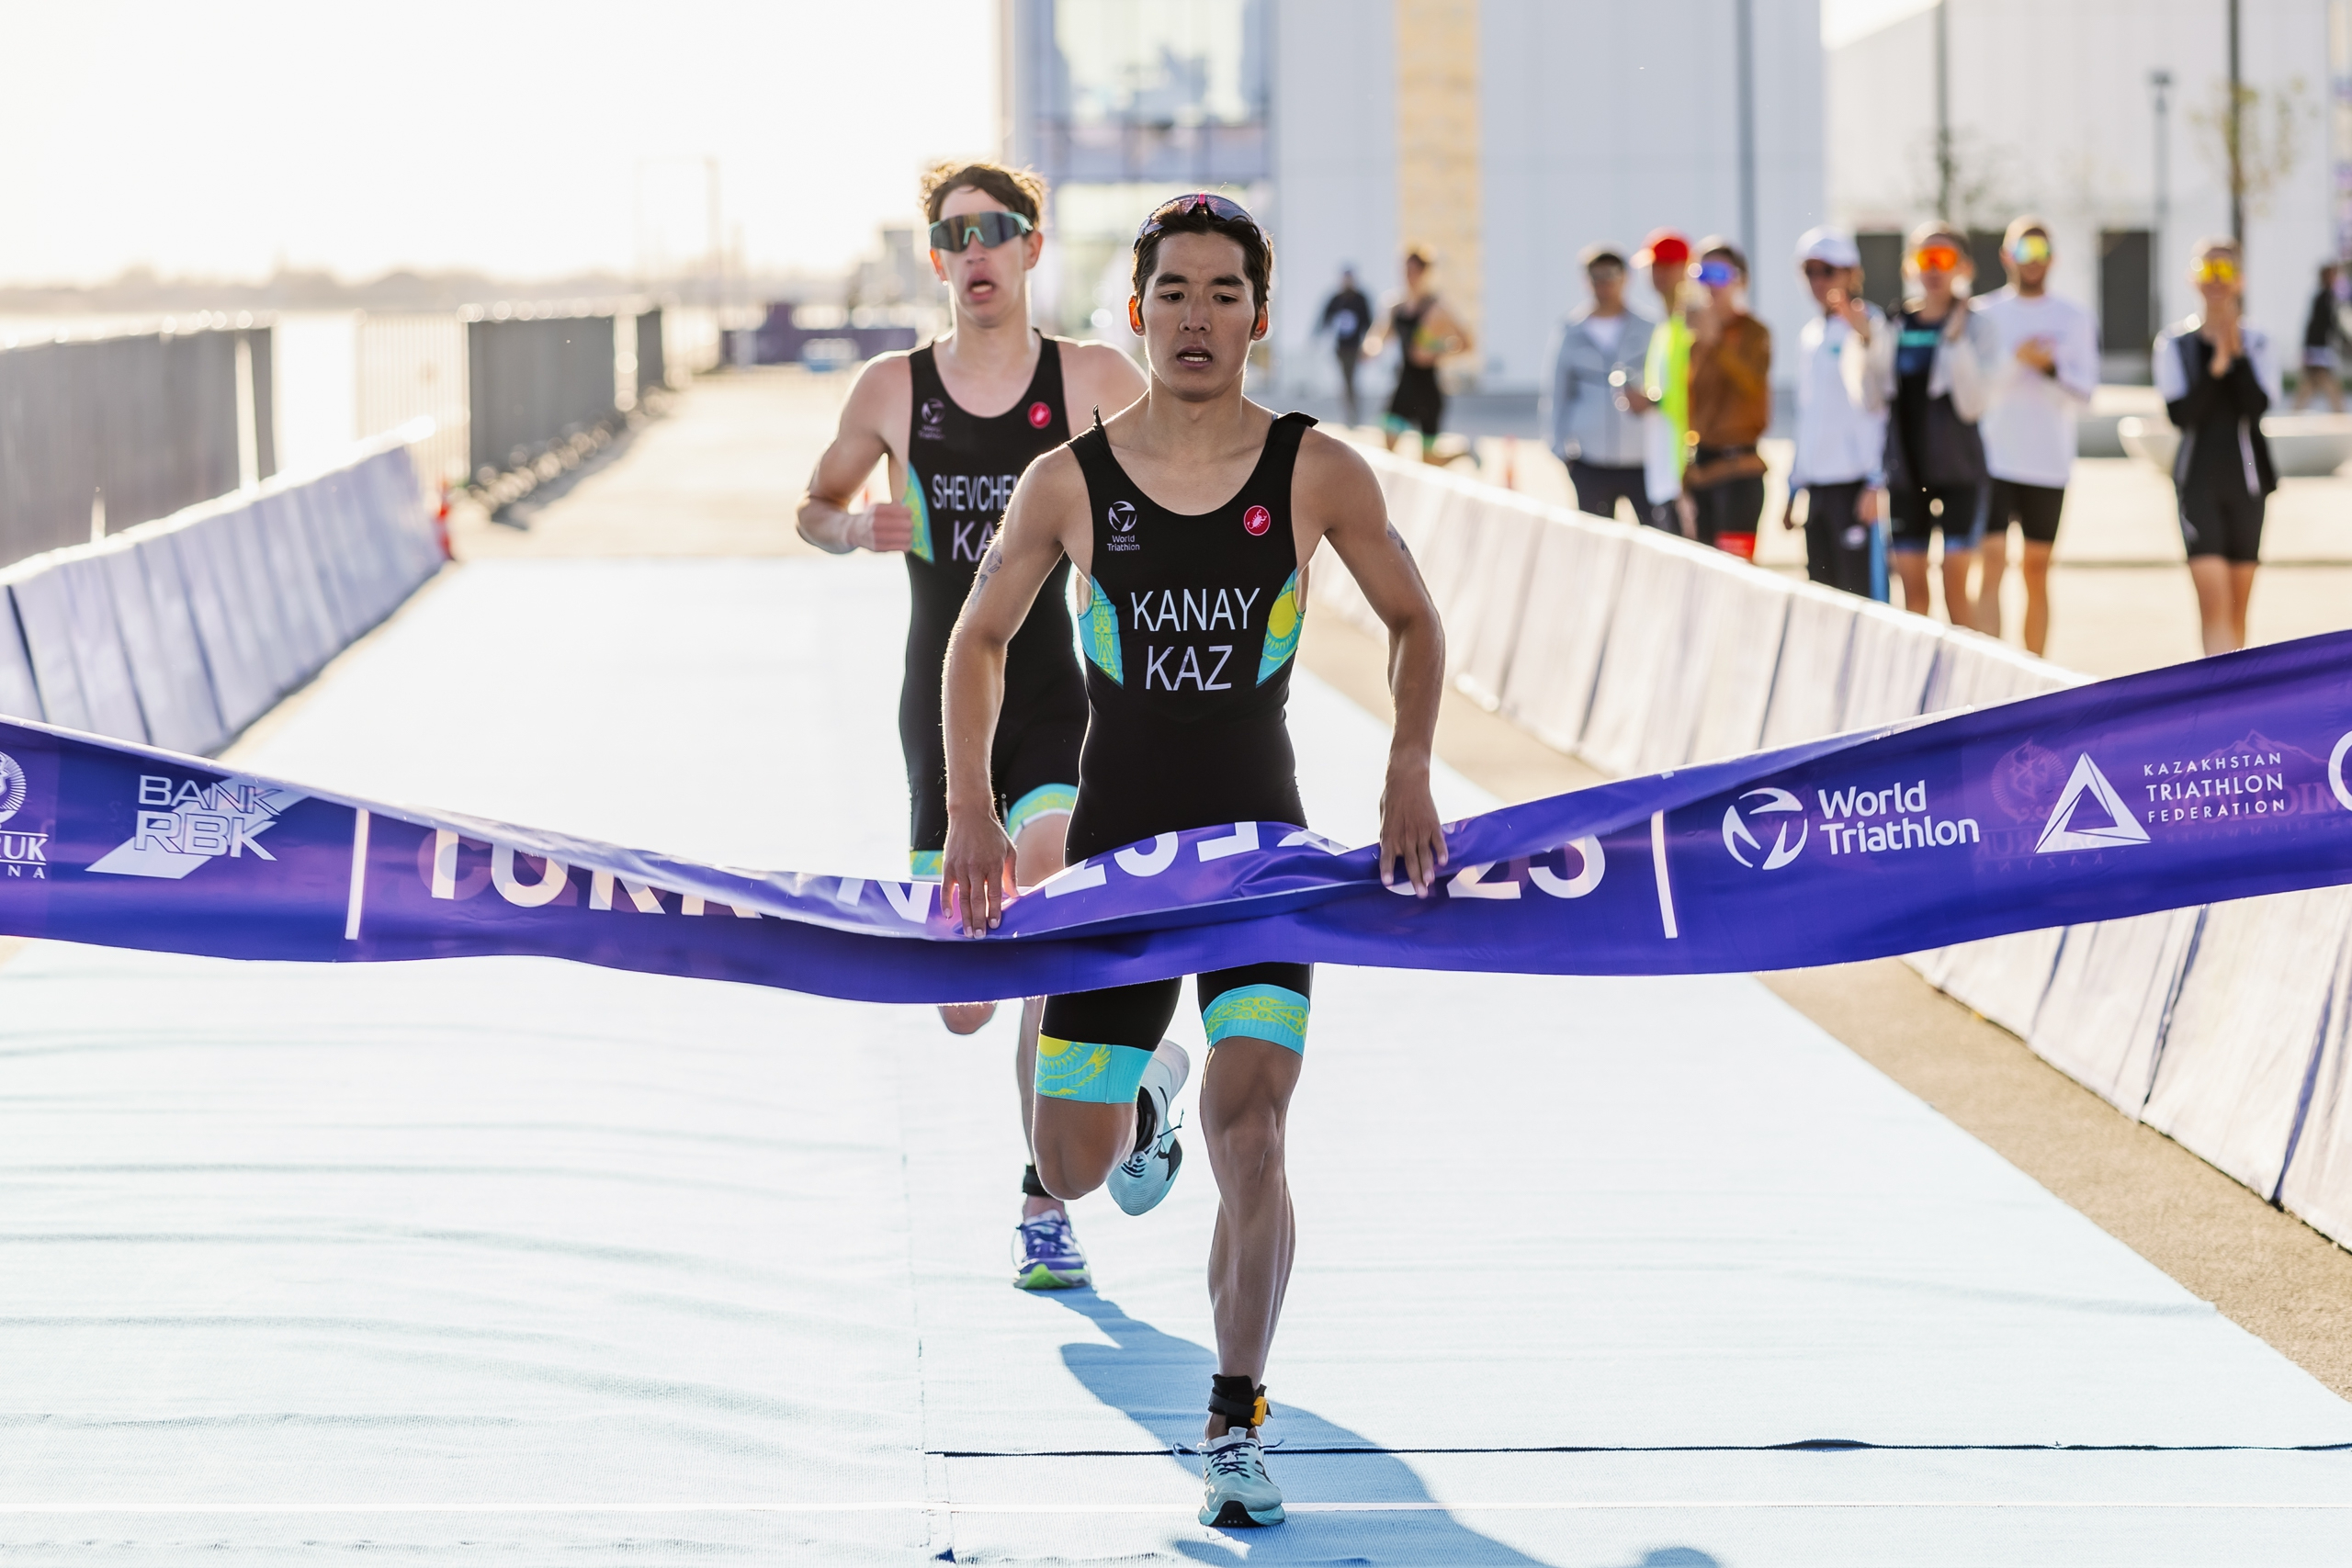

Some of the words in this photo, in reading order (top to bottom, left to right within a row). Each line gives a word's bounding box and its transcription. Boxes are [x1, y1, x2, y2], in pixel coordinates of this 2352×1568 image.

[1106, 542, 1140, 552] Triathlon
[1112, 535, 1136, 544] World
[1130, 588, 1261, 632] KANAY
[1146, 645, 1233, 691] KAZ
[2143, 752, 2282, 776] KAZAKHSTAN
[138, 774, 281, 816] BANK
[1817, 779, 1928, 819] World
[2146, 773, 2284, 803] TRIATHLON
[2148, 799, 2286, 823] FEDERATION
[0, 835, 48, 862] UK
[134, 809, 278, 862] RBK
[1820, 815, 1981, 855] Triathlon
